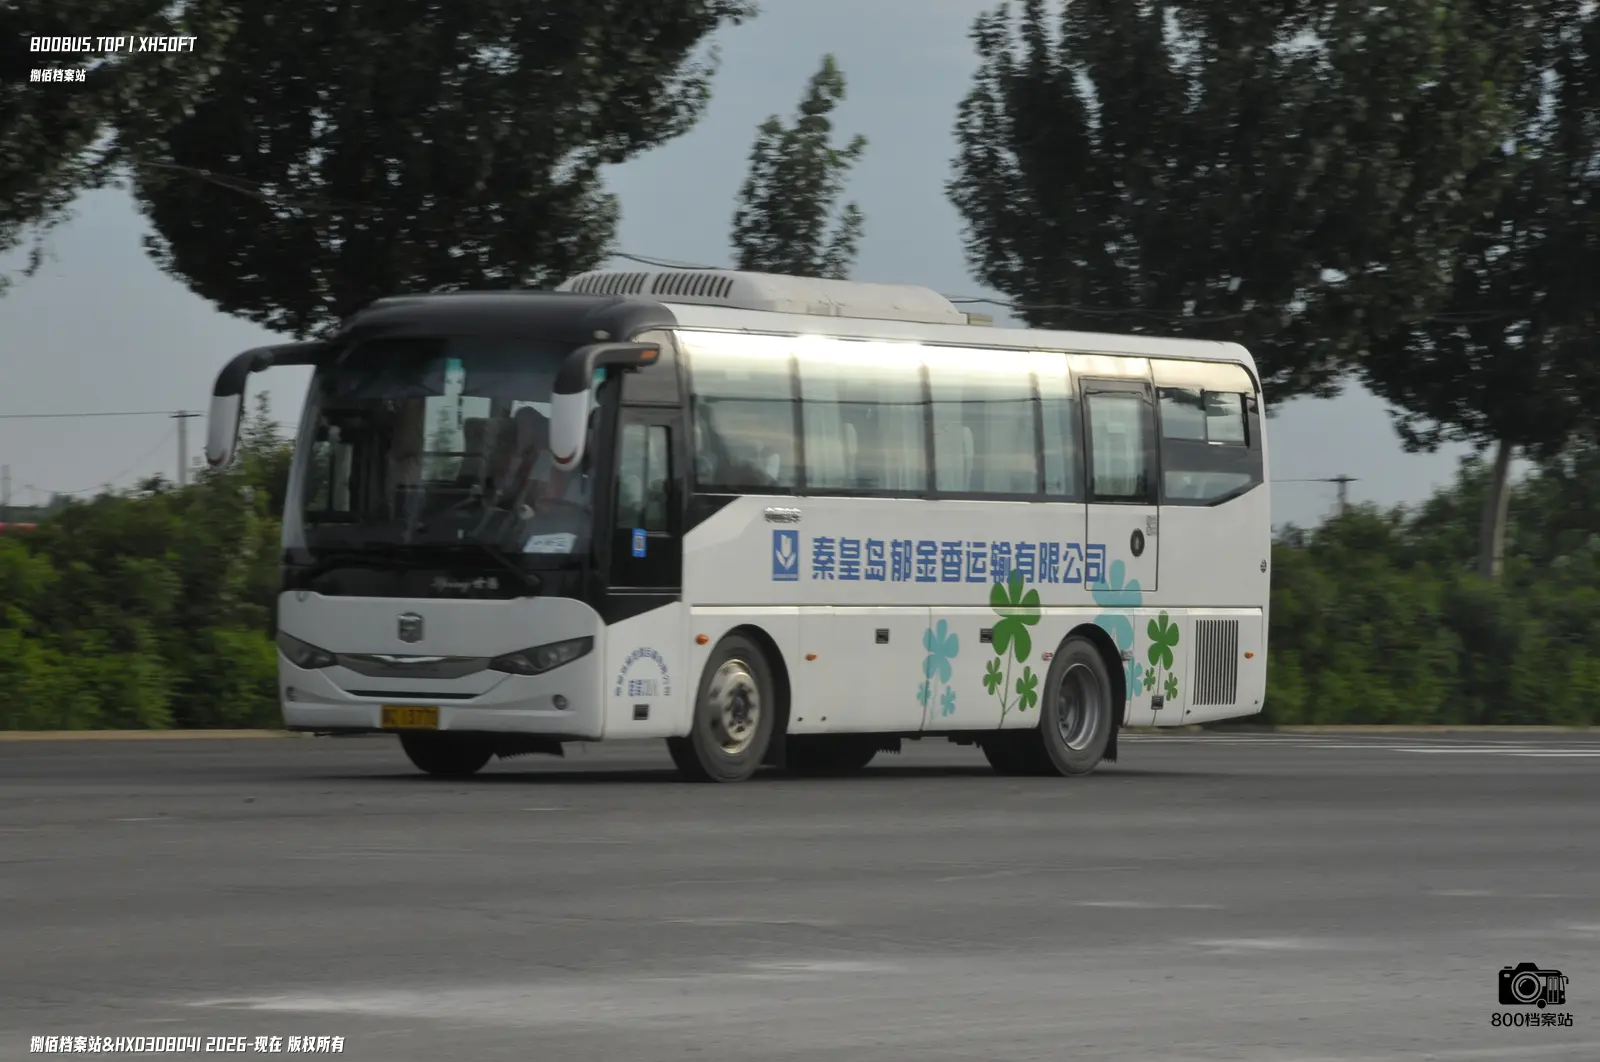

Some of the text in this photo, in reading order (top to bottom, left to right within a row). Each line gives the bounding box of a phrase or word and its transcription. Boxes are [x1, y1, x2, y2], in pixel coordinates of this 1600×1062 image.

[811, 536, 1107, 584] 秦皇岛郁金香运输有限公司
